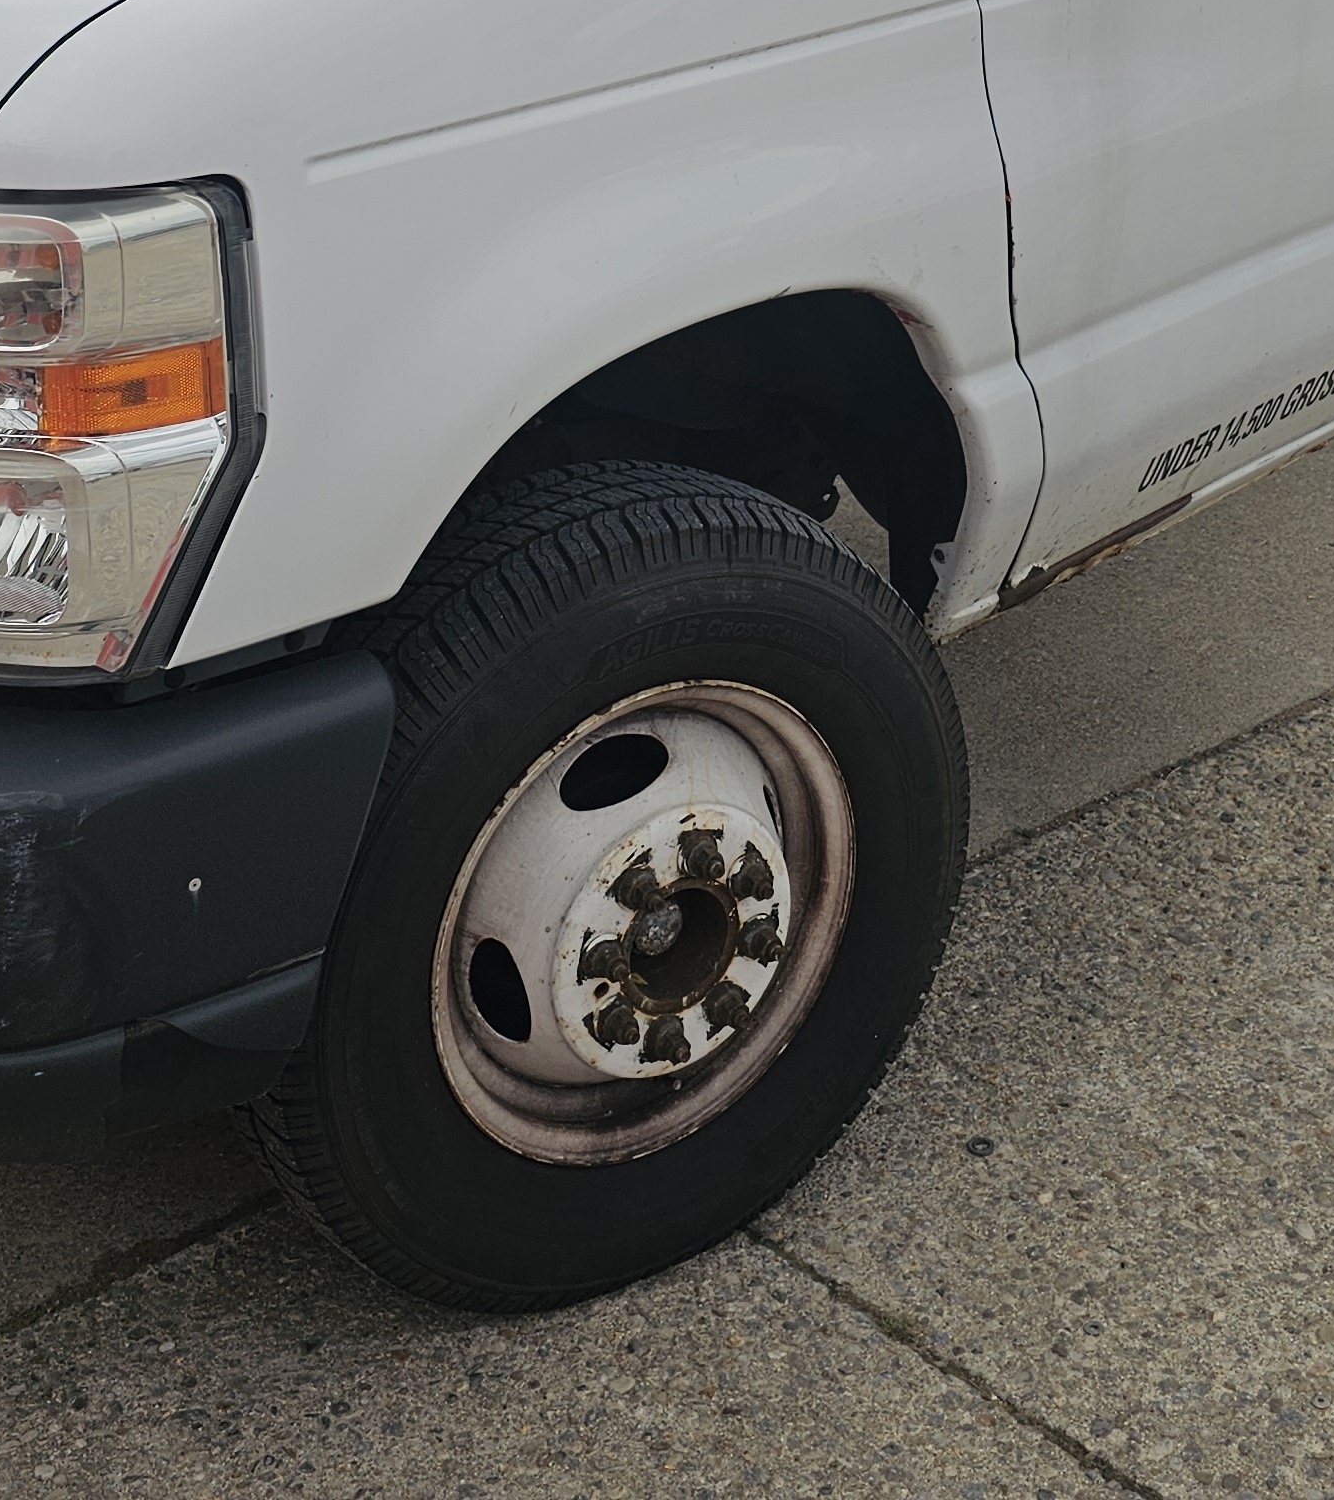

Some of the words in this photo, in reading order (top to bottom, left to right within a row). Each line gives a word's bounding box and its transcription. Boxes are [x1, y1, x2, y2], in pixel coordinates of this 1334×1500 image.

[1137, 423, 1221, 493] UNDER
[1217, 393, 1285, 452] 14,500
[598, 616, 701, 680] AGILIS
